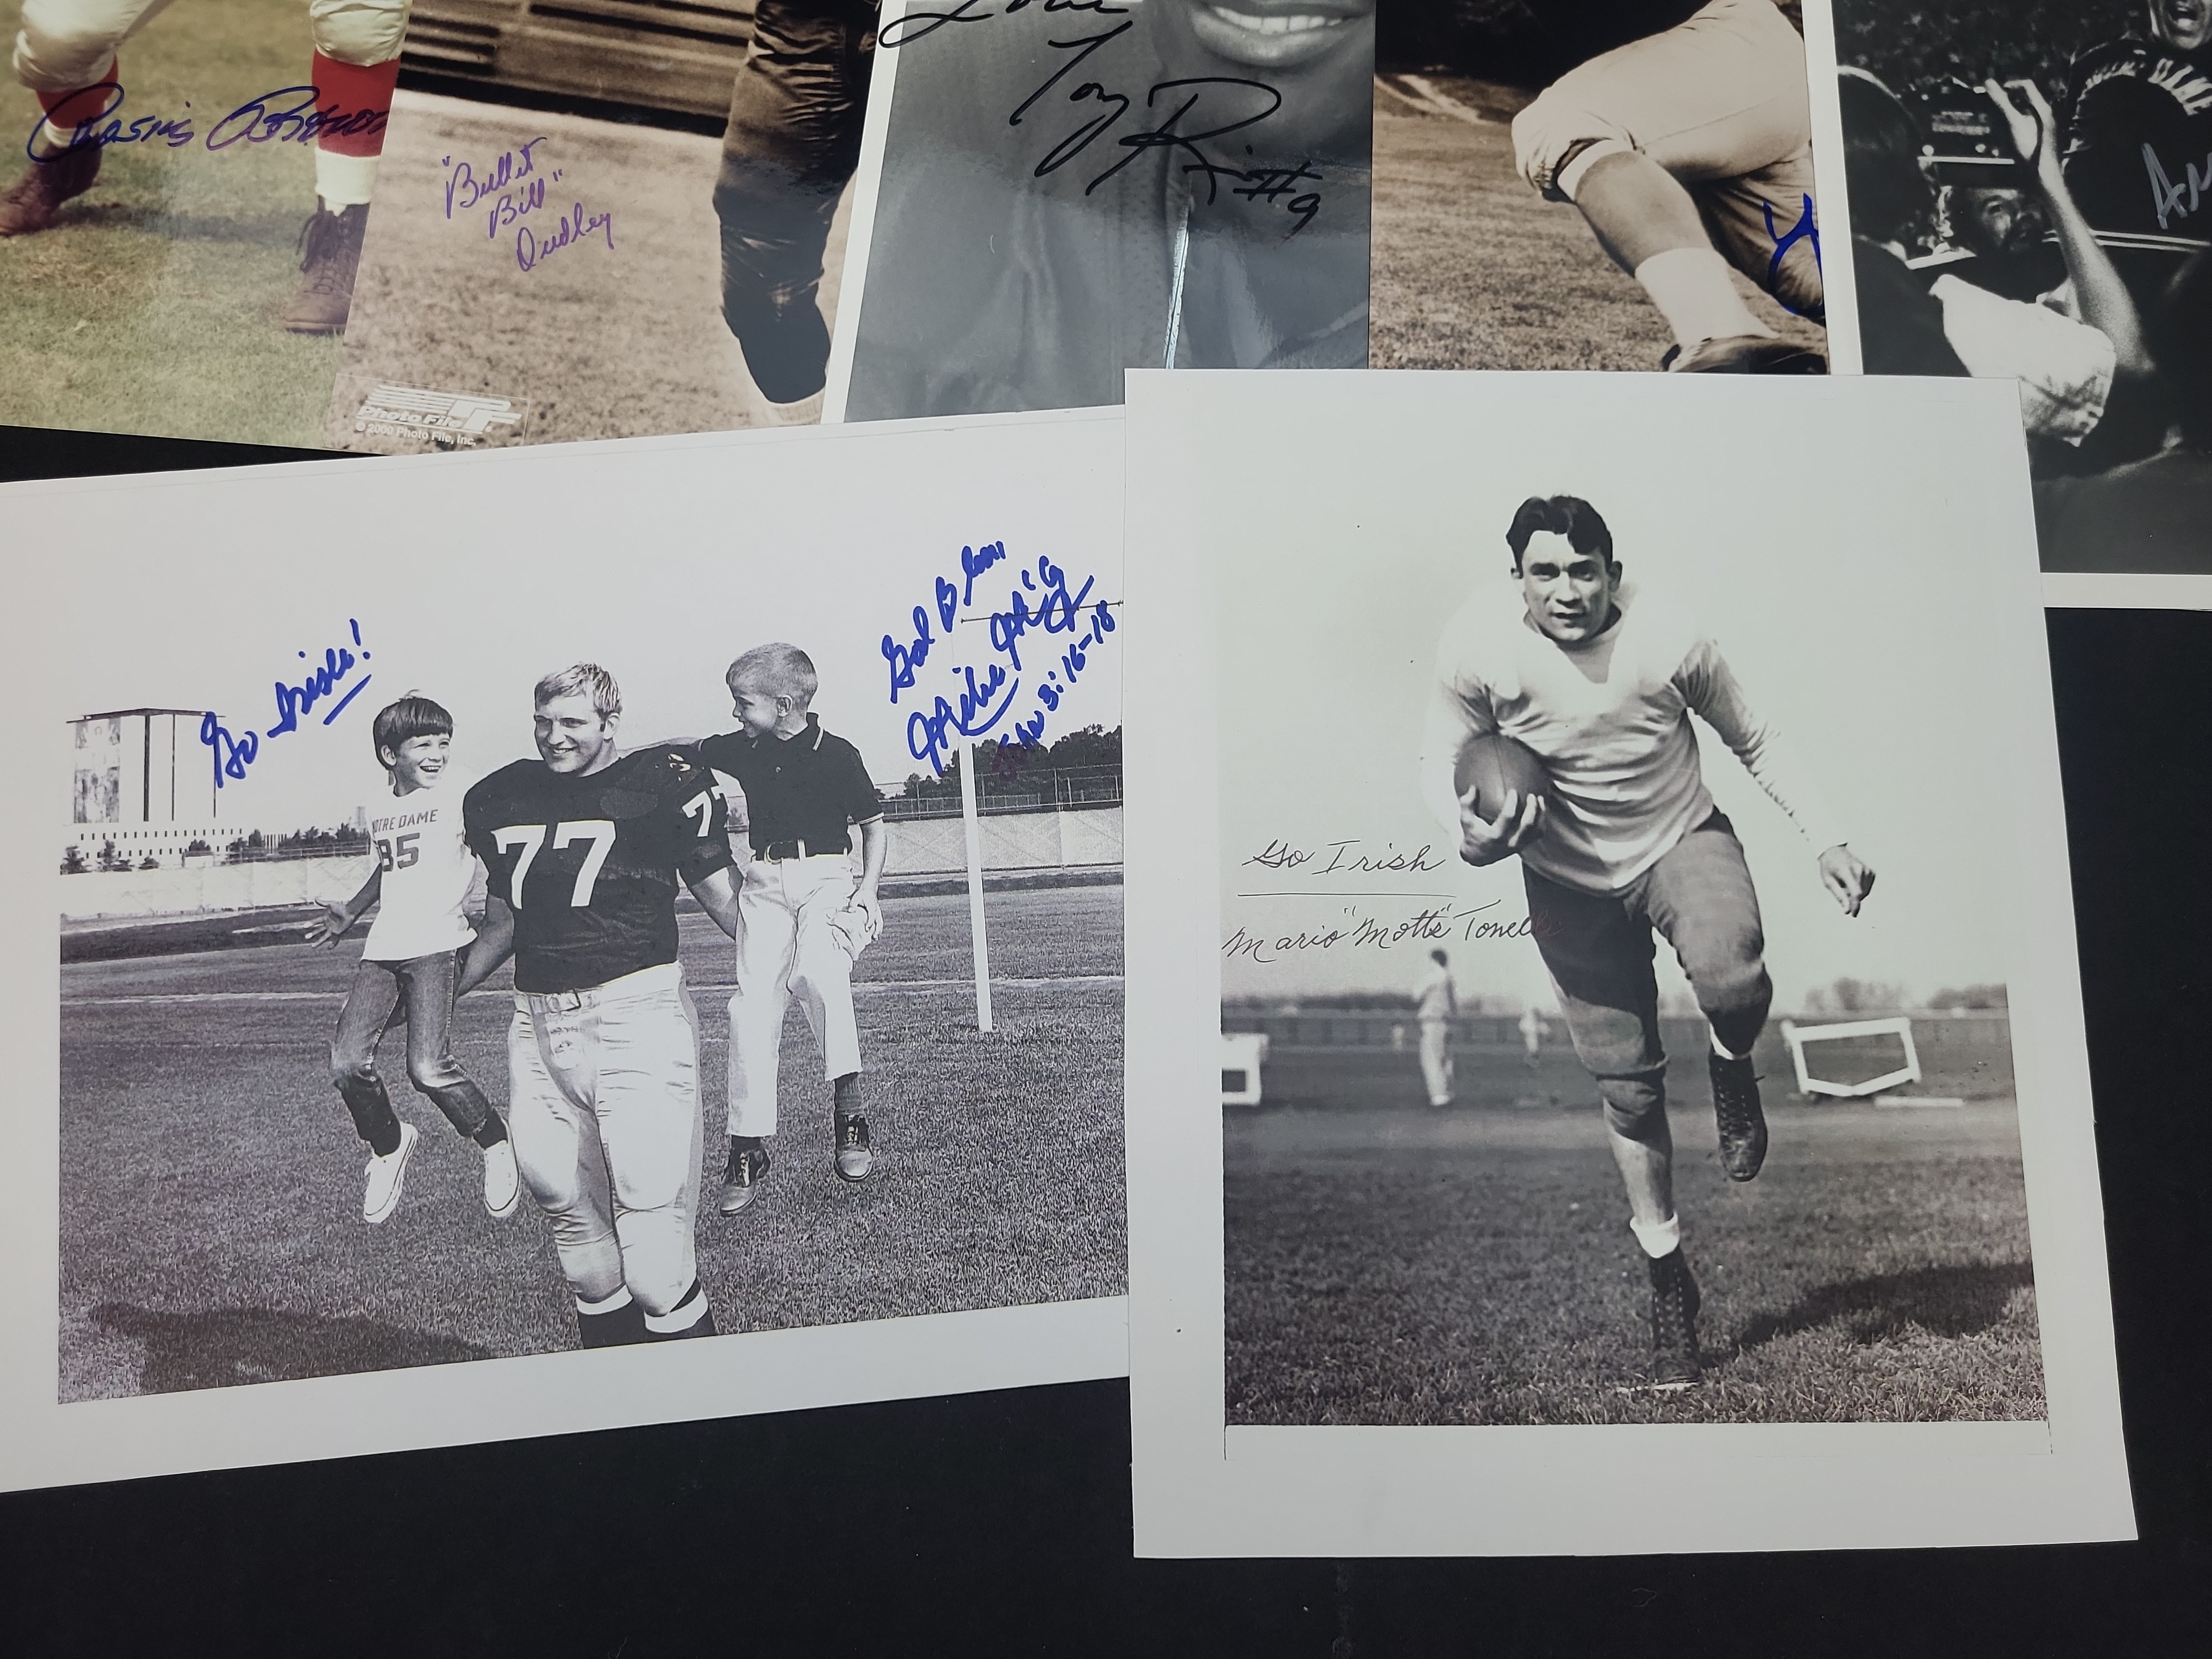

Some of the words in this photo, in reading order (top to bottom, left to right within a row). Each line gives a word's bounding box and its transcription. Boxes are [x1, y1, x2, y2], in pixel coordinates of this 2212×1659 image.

[517, 202, 614, 272] Dudley
[356, 405, 422, 422] Photo
[422, 413, 463, 429] File
[368, 424, 394, 435] 2000
[396, 427, 429, 440] Photo
[431, 431, 454, 445] File,
[457, 434, 477, 446] Inc.
[398, 809, 439, 829] DAME
[491, 819, 617, 910] 77
[1241, 839, 1316, 869] Go
[1311, 839, 1447, 875] Irish
[1221, 925, 1349, 963] Mario
